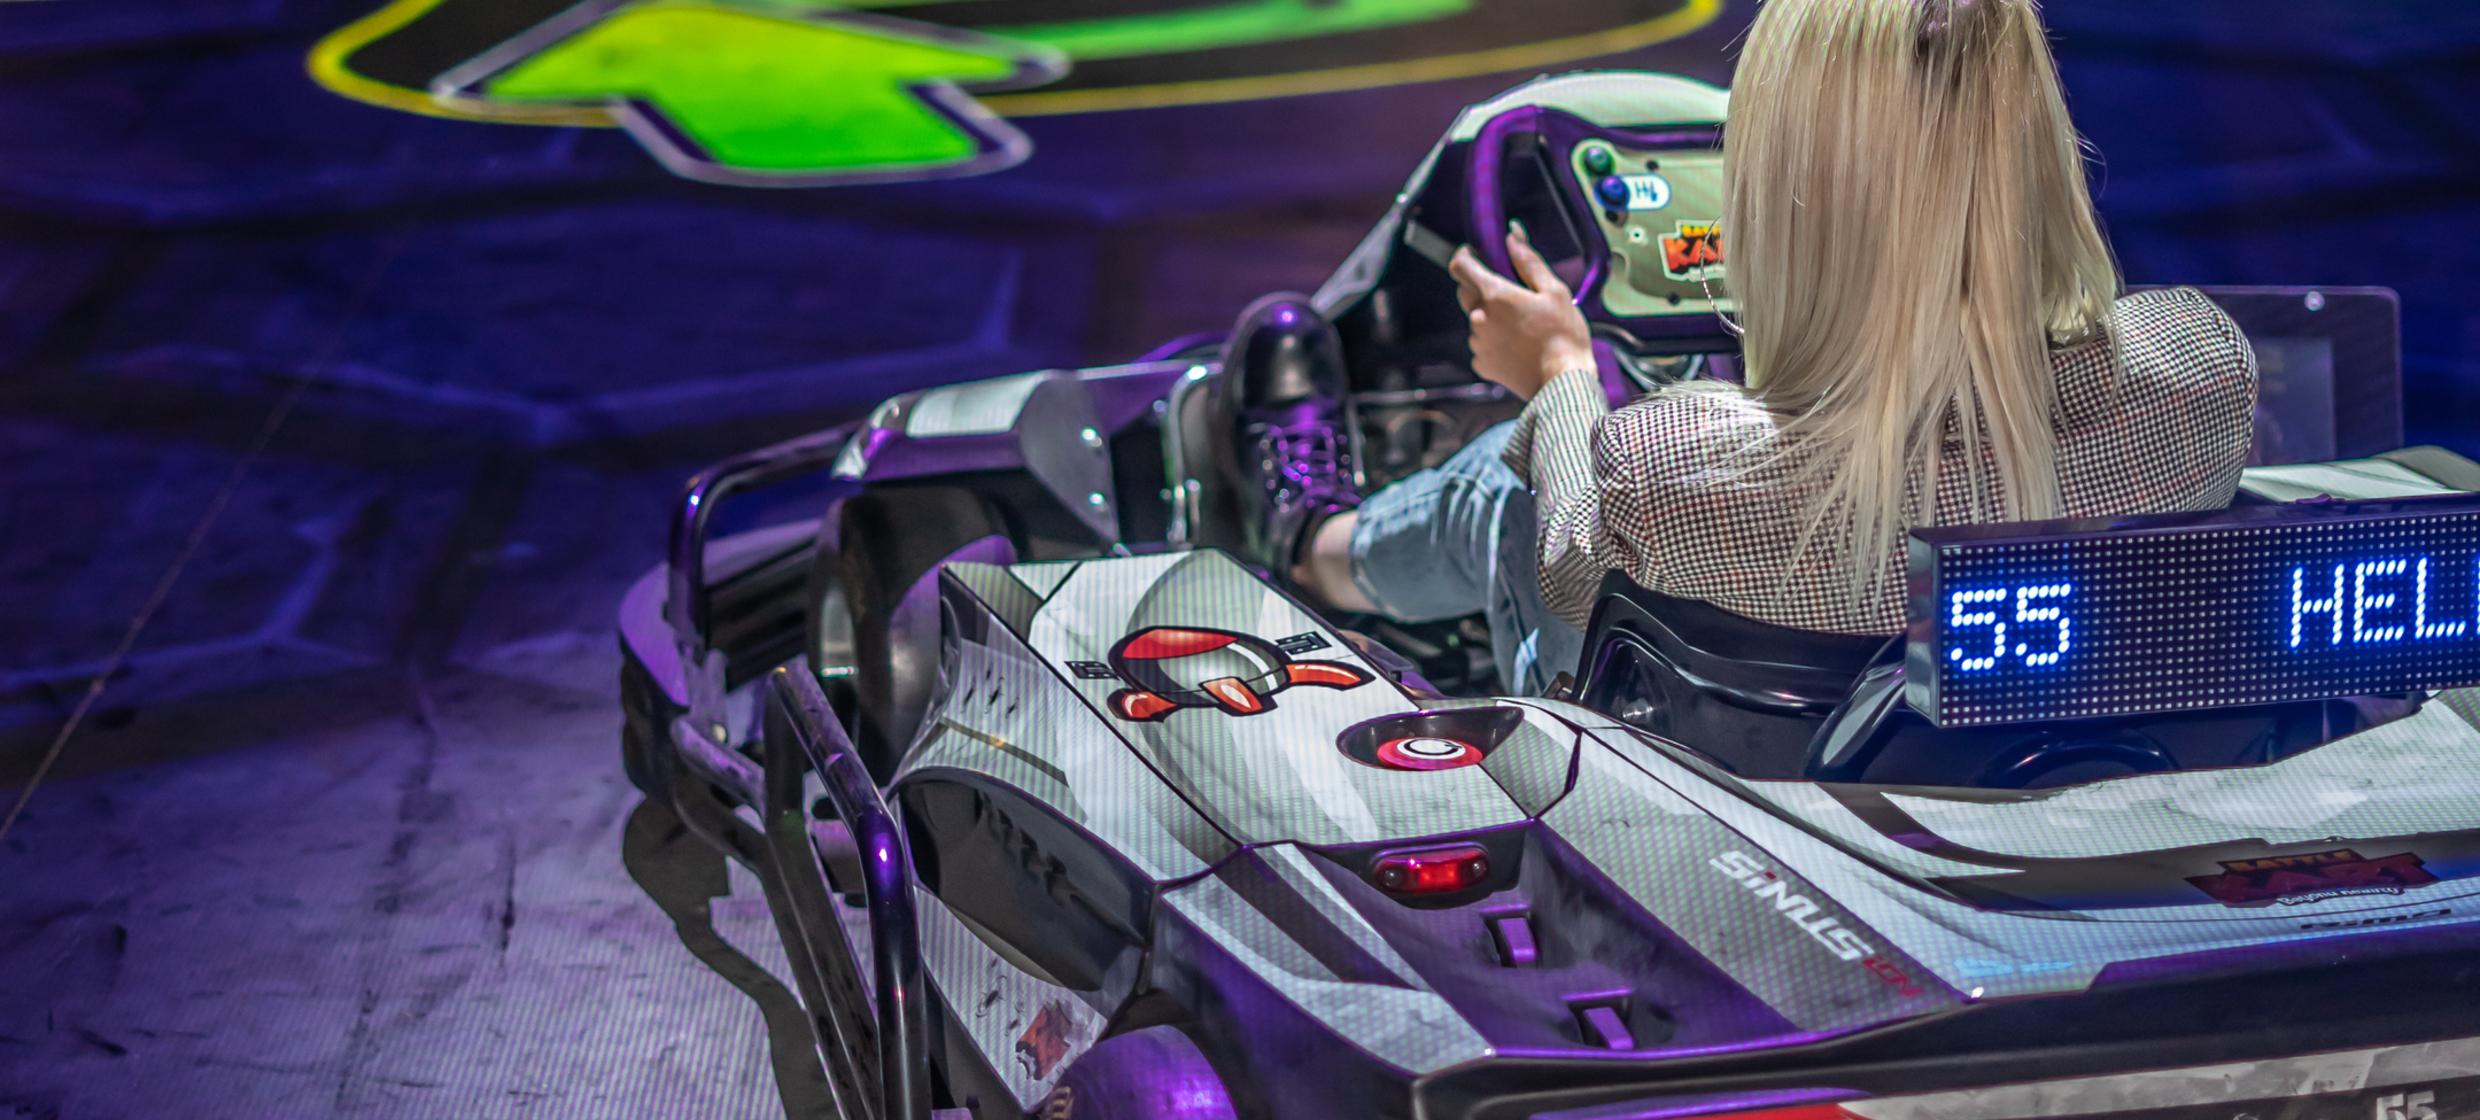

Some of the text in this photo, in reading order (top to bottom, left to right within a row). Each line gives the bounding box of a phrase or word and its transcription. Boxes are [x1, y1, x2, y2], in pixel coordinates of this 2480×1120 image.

[1664, 237, 1725, 271] KA
[1951, 556, 2480, 671] 55 HEL
